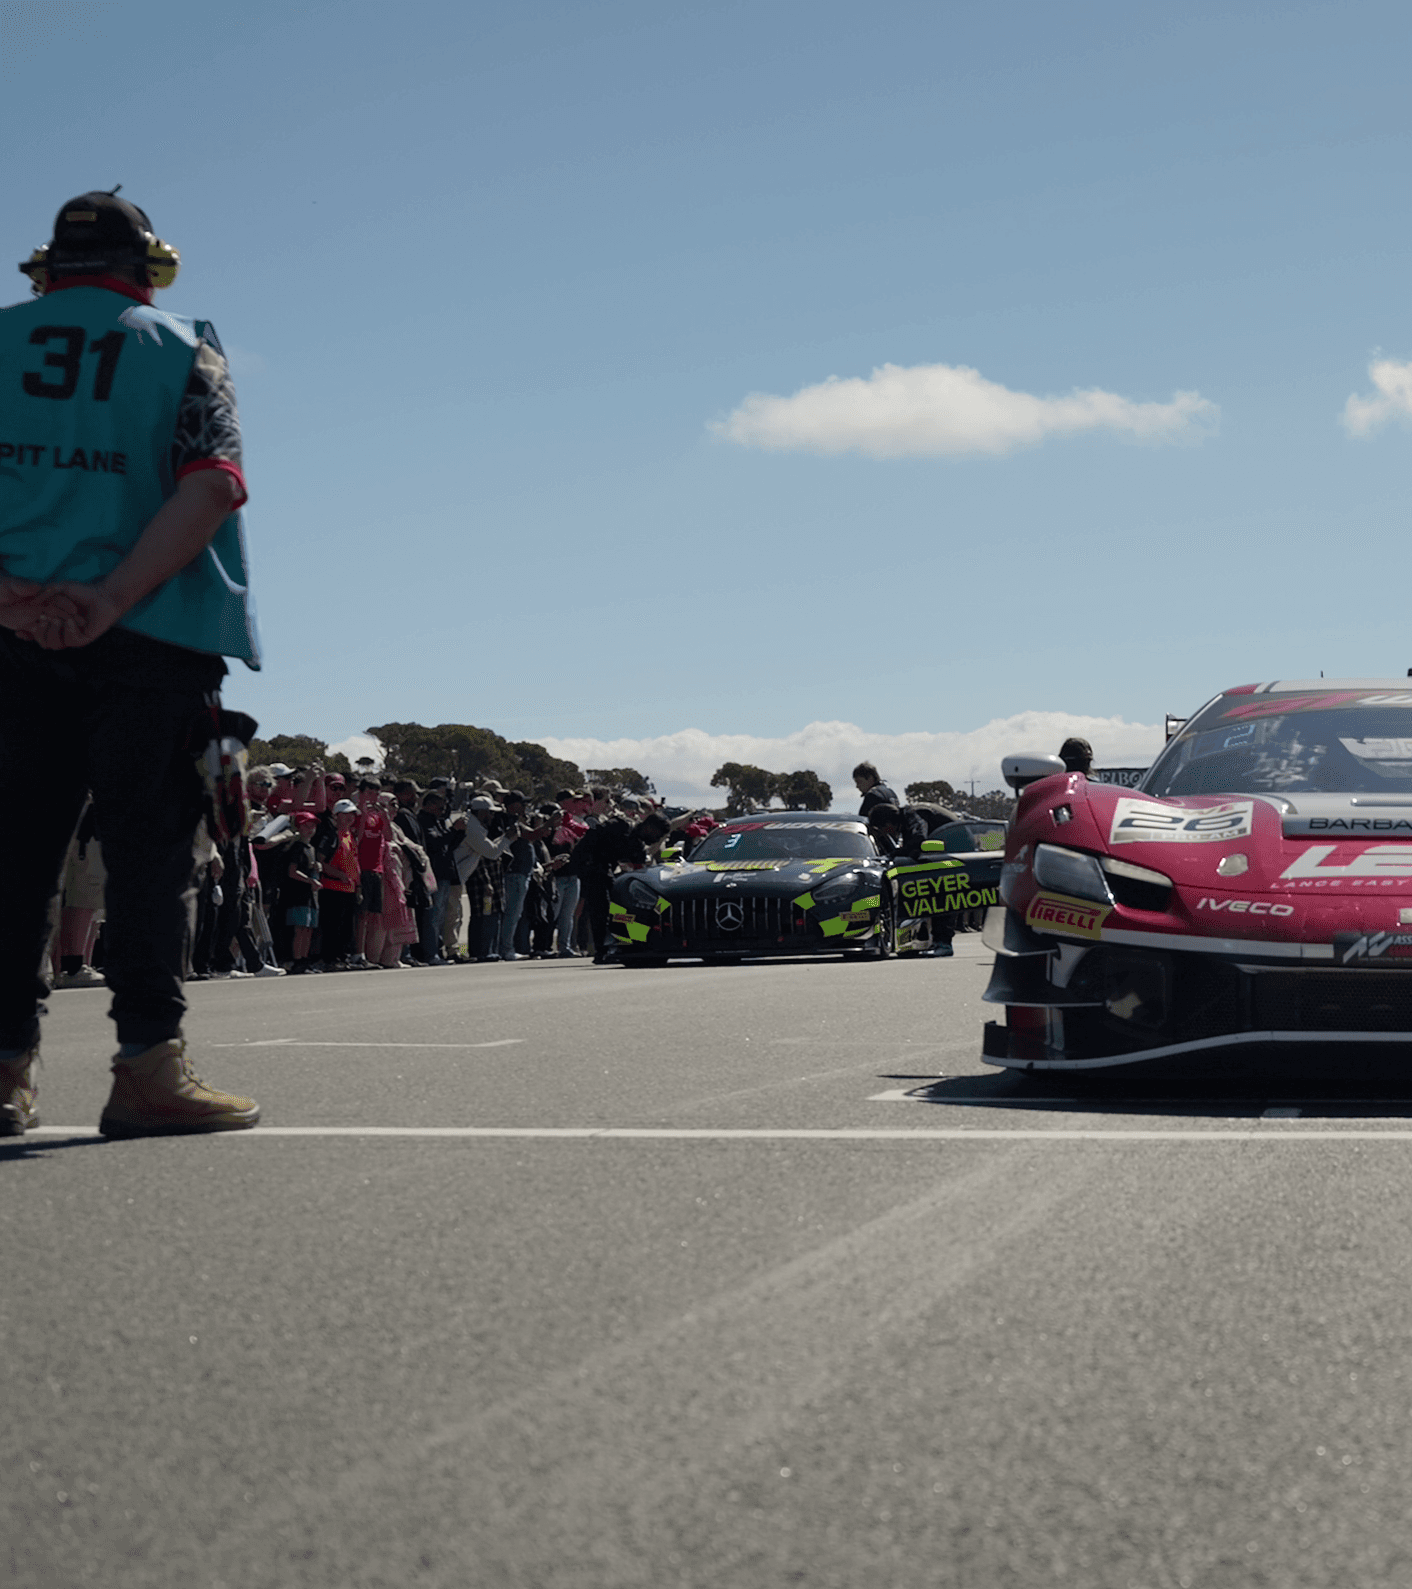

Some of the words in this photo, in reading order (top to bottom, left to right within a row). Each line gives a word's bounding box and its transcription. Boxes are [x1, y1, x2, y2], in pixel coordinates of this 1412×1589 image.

[22, 324, 127, 401] 31
[0, 443, 46, 466] PIT
[53, 446, 128, 475] LANE
[724, 833, 742, 849] 3
[901, 872, 971, 898] GEYER
[903, 887, 1001, 917] VALMON
[1029, 898, 1101, 931] PIRELLI
[1196, 897, 1295, 917] IVECO
